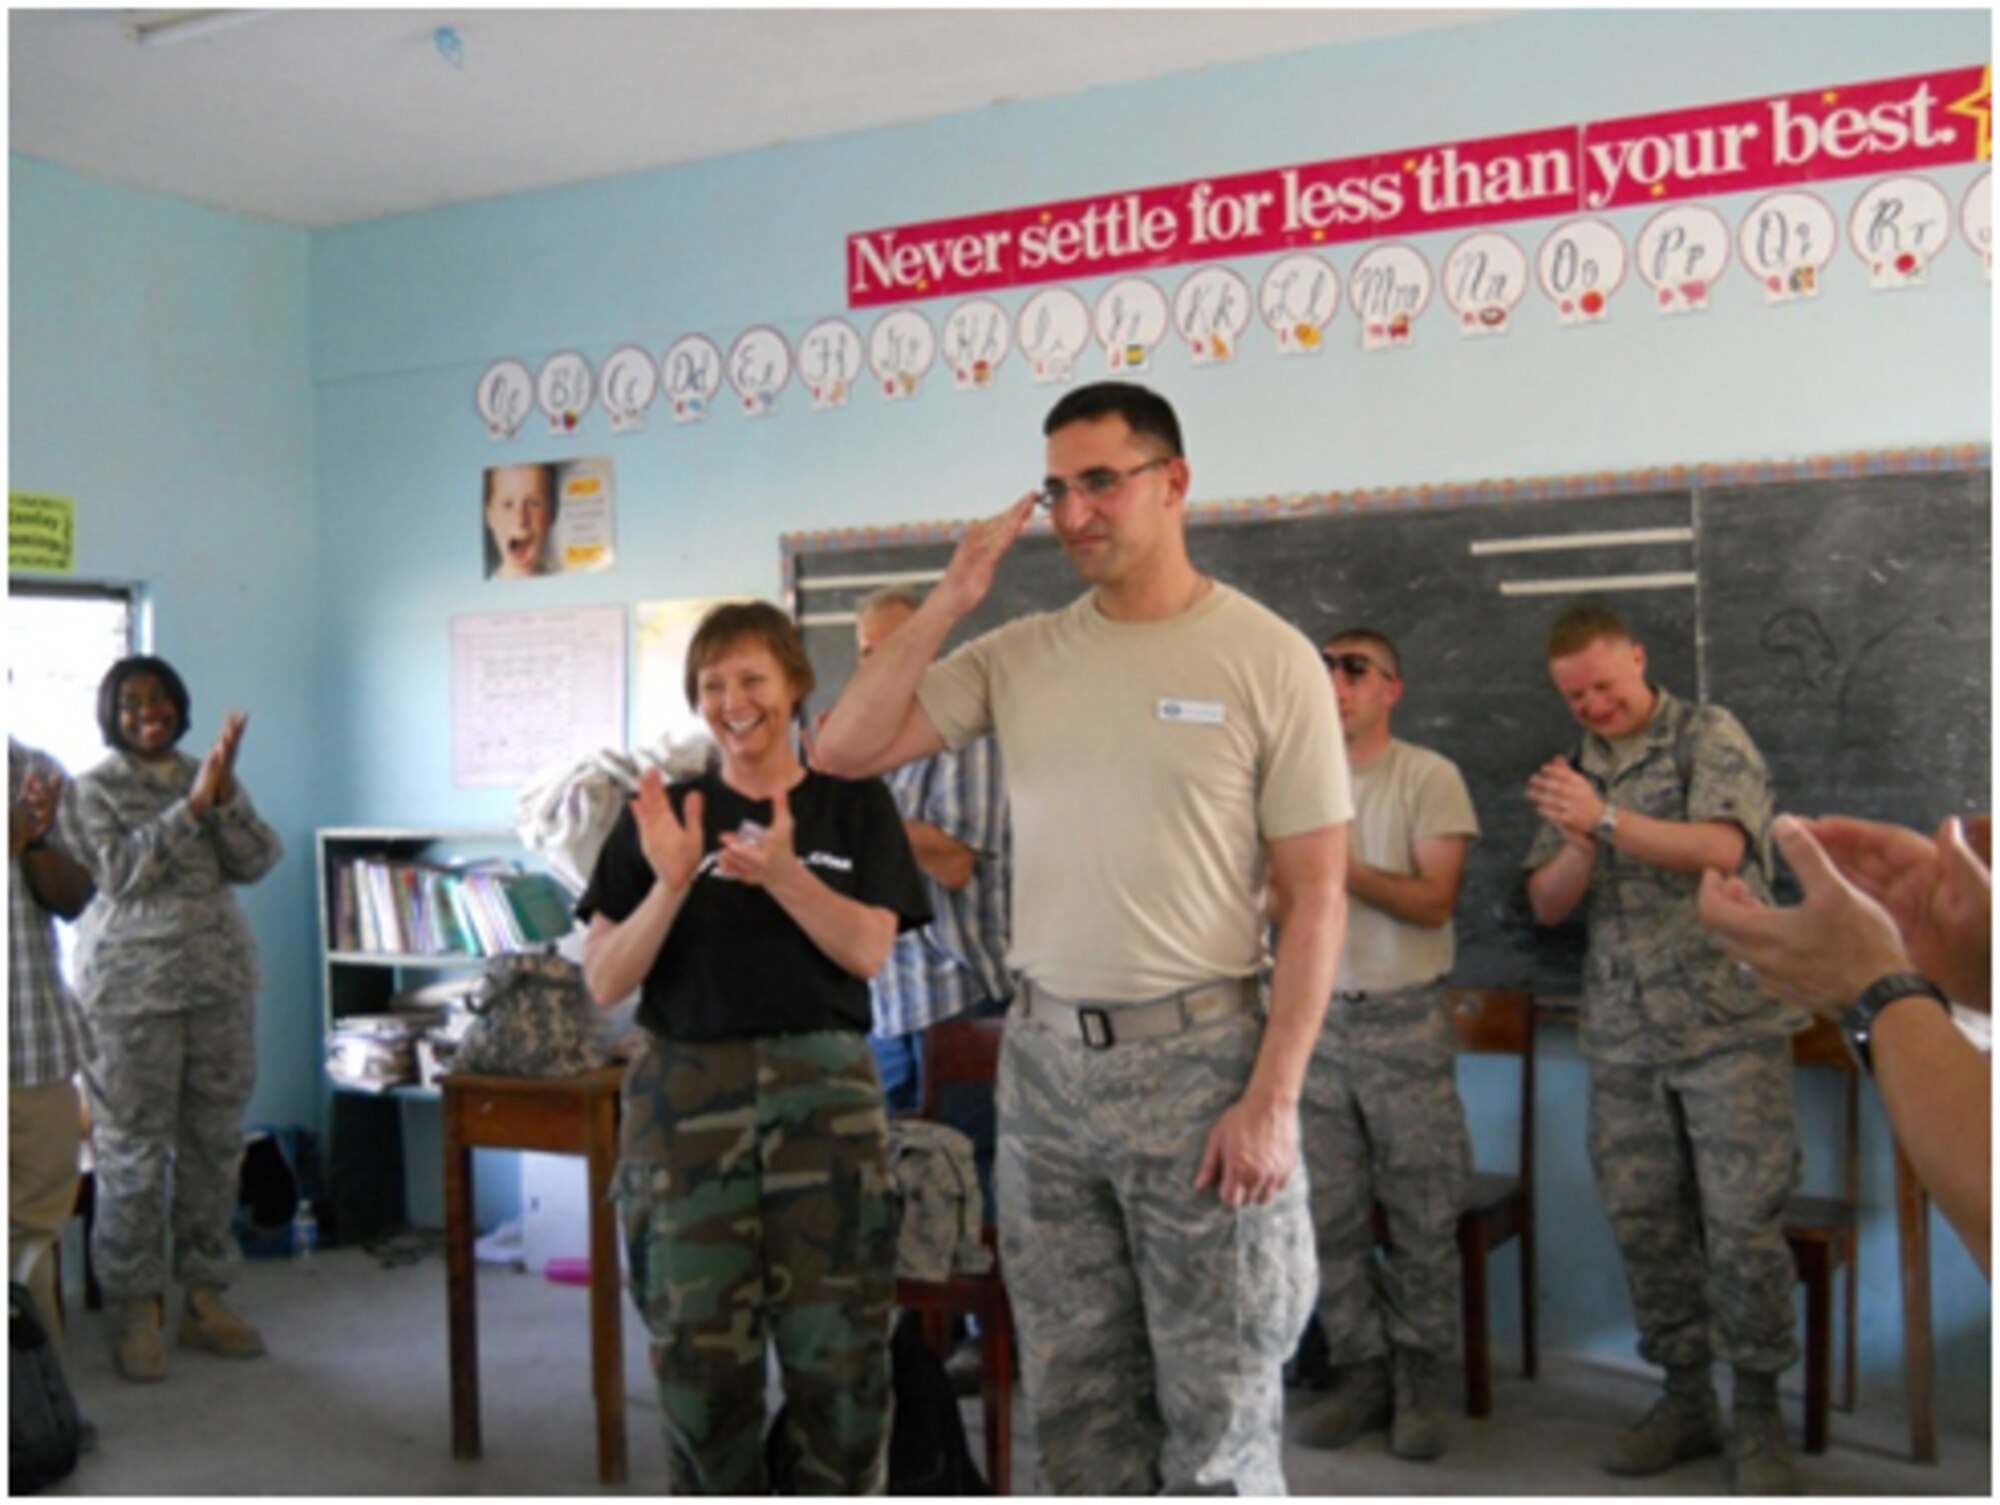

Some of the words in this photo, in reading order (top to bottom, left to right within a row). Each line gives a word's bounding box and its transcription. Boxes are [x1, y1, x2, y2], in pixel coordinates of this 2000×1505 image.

[850, 230, 1010, 292] Never
[1019, 196, 1177, 267] settle
[1188, 181, 1273, 244] for
[1281, 168, 1404, 231] less
[1414, 147, 1573, 214] than
[1587, 121, 1759, 208] your
[1767, 82, 1957, 166] best.
